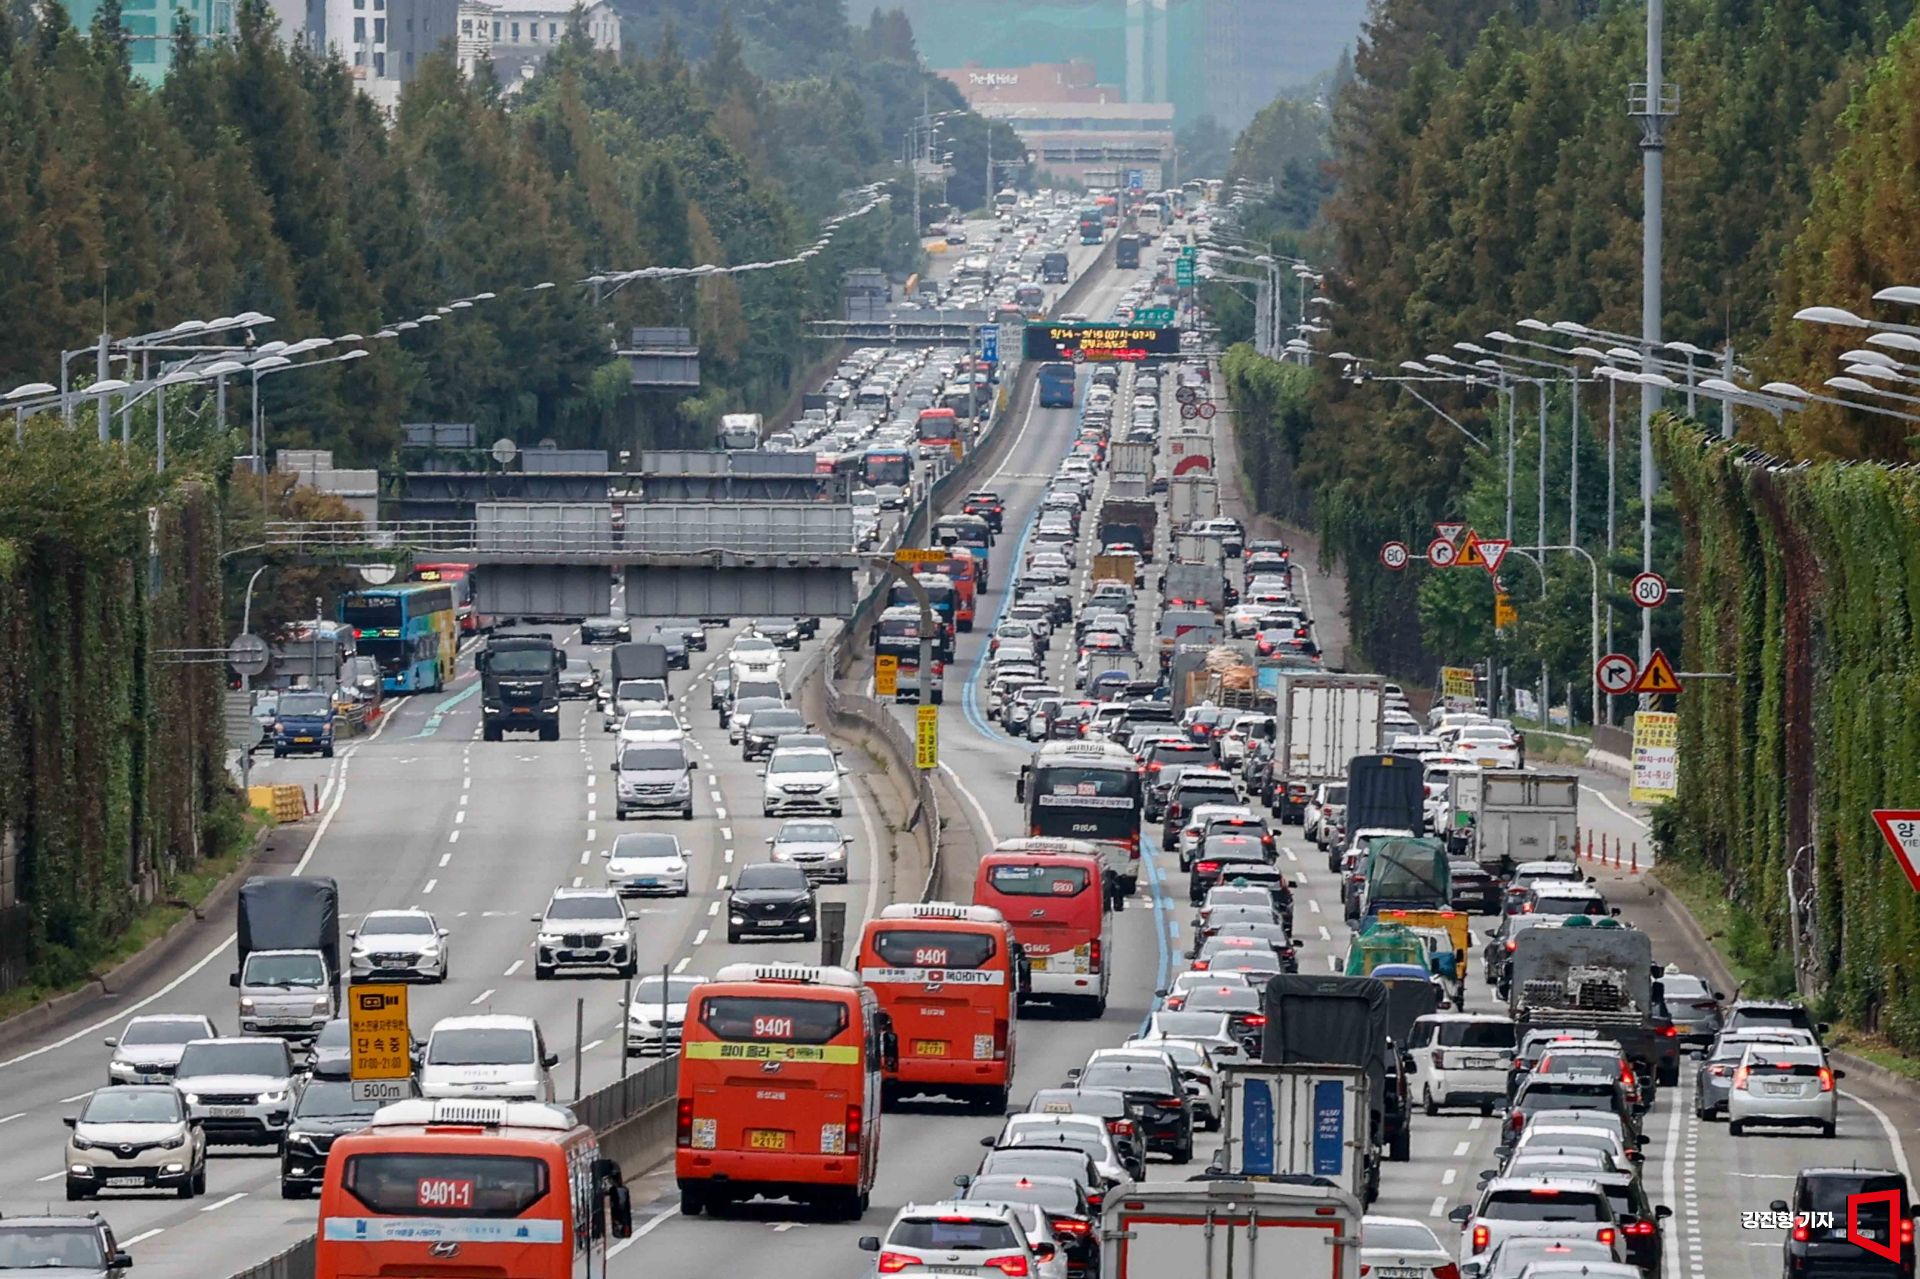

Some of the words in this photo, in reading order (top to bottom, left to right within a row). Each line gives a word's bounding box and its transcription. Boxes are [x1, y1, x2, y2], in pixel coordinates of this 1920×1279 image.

[1387, 549, 1403, 562] 80
[1640, 582, 1660, 599] 80
[1897, 822, 1915, 838] 양
[916, 949, 947, 964] 9401
[755, 1018, 792, 1036] 9401
[364, 1084, 399, 1098] 500m
[420, 1181, 470, 1205] 9401-1
